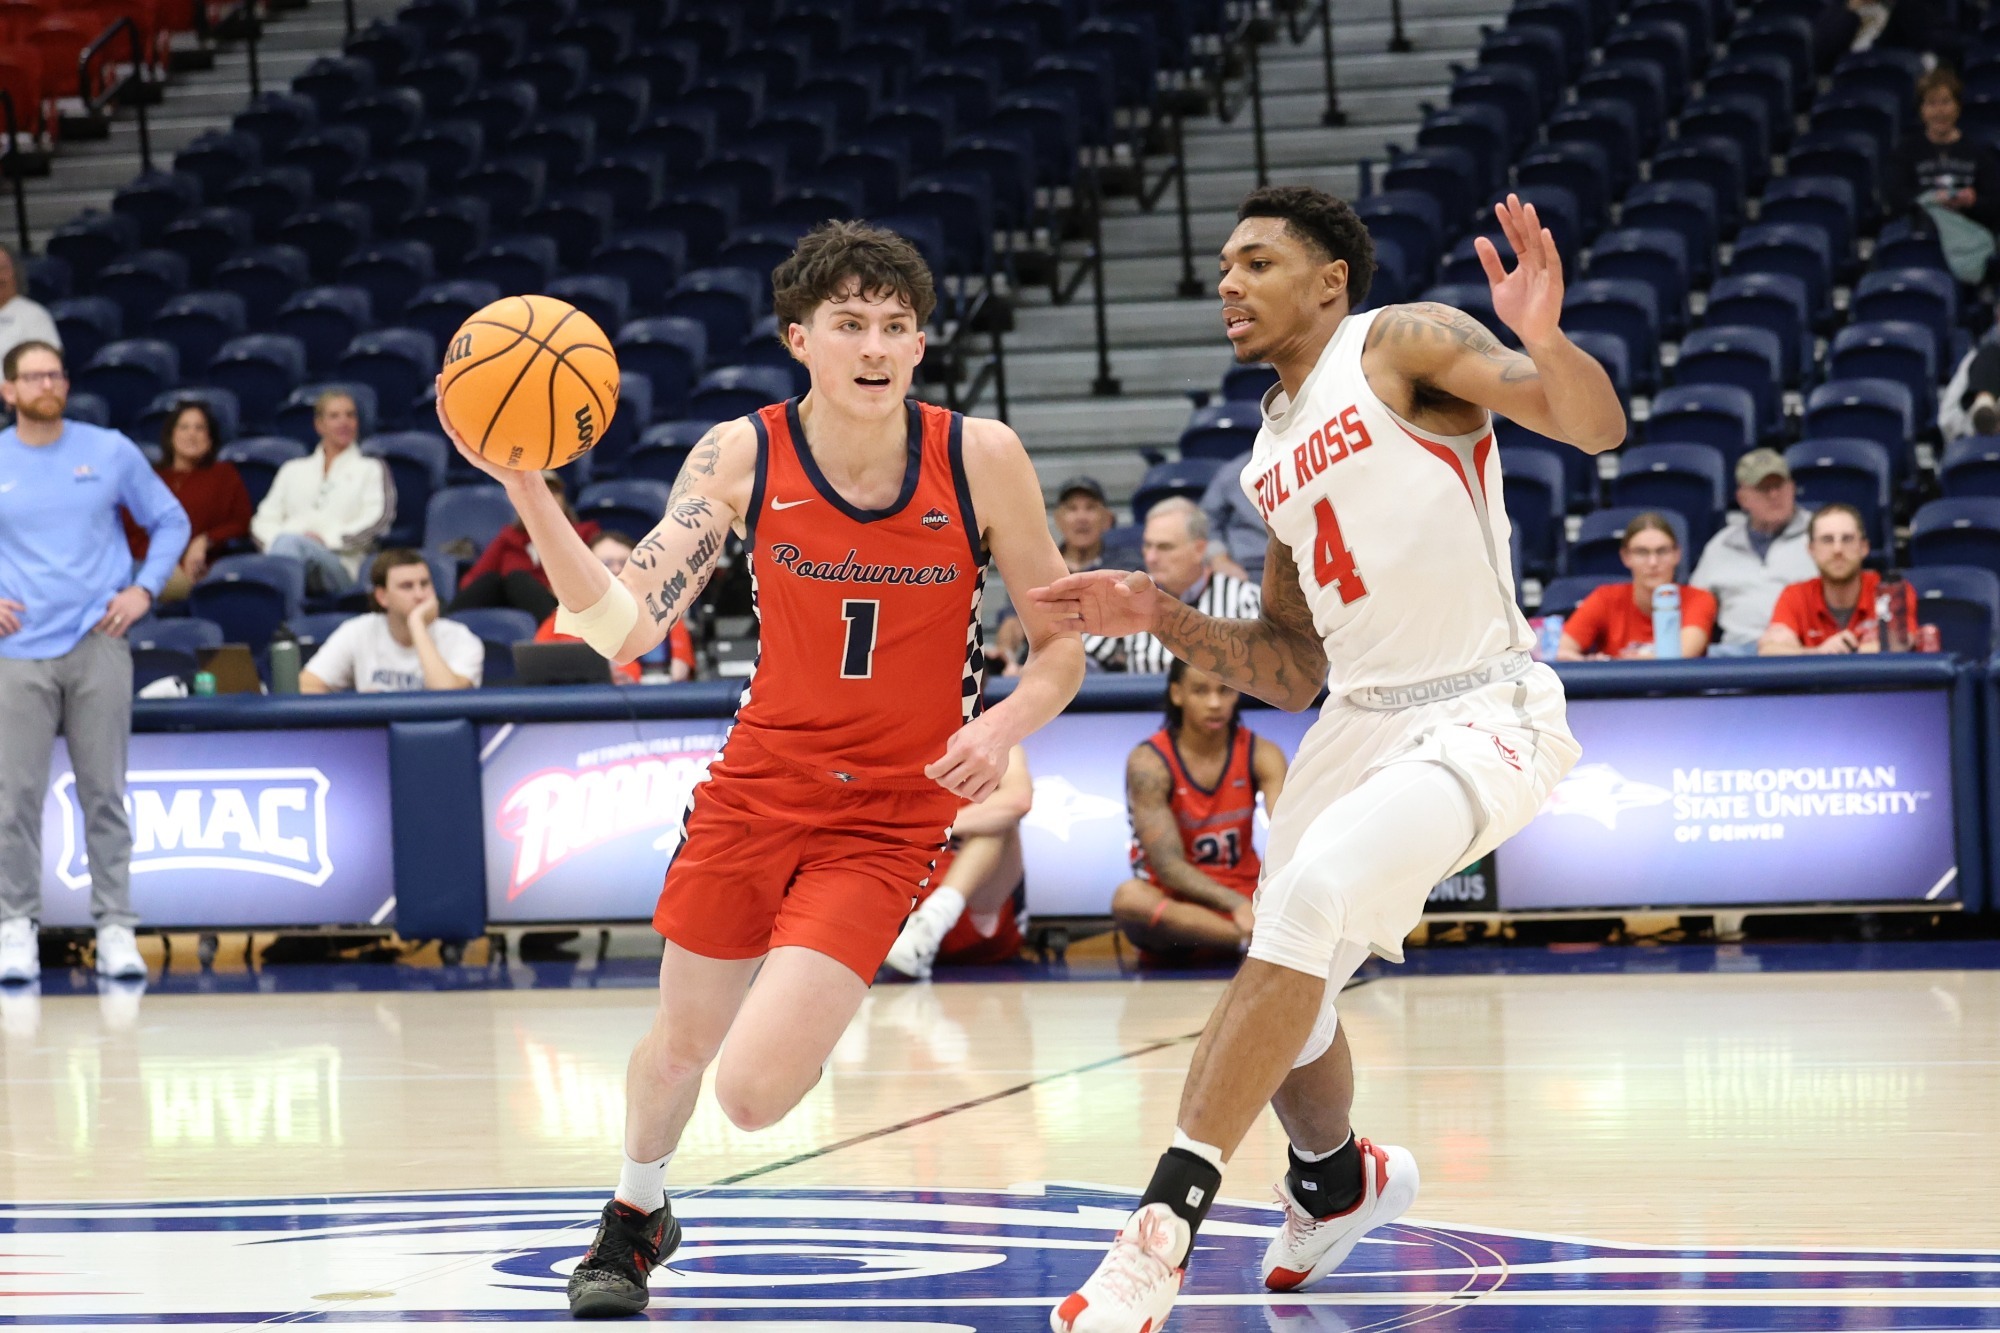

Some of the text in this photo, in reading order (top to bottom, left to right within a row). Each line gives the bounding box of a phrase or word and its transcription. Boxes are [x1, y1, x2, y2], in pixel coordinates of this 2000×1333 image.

[1254, 404, 1373, 521] SUL ROSS
[922, 513, 949, 525] RMAC
[771, 543, 960, 585] Roadrunners
[1312, 493, 1370, 608] 4
[645, 569, 687, 625] Love
[840, 598, 880, 679] 1
[1673, 765, 1896, 795] METROPOLITAN
[123, 787, 311, 863] MAC
[1673, 790, 1919, 821] STATE UNIVERSITY
[1193, 828, 1241, 869] 21
[1674, 823, 1785, 843] OF DENVER
[1427, 873, 1487, 902] ONUS
